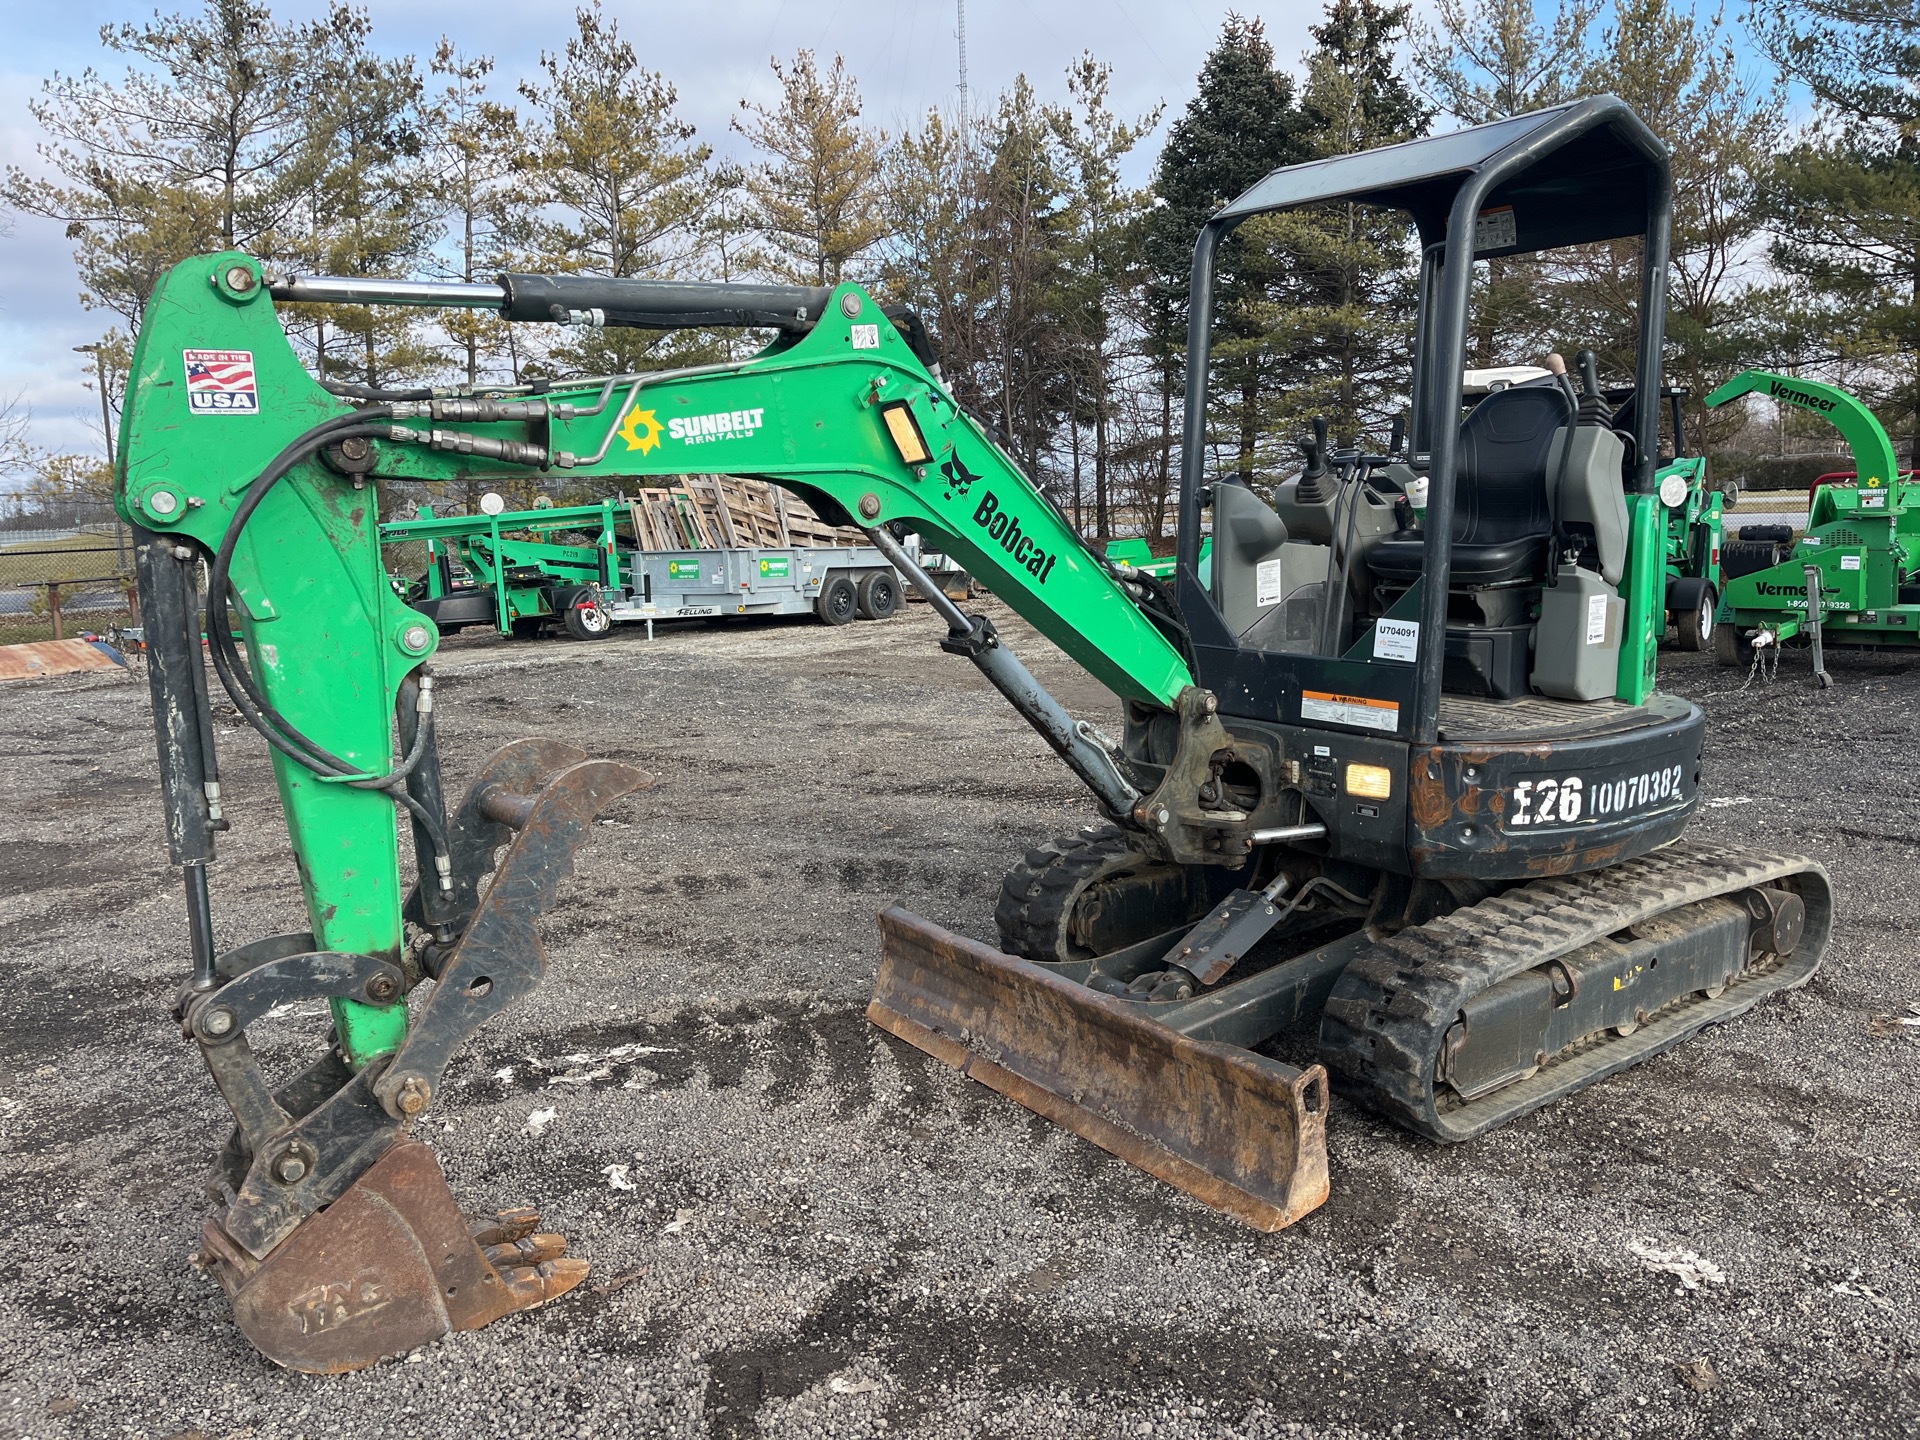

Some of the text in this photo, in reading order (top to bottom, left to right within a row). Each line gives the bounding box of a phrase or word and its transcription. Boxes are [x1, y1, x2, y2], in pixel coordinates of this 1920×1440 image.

[188, 353, 216, 361] MADE
[193, 393, 253, 408] USA
[1770, 381, 1837, 413] Vermeer
[667, 408, 764, 439] SUNBELT
[972, 489, 1057, 585] Bobcat
[675, 607, 713, 616] FELLING
[1379, 625, 1416, 638] U704091
[1338, 696, 1368, 705] WARNING
[1589, 764, 1682, 816] 10070382
